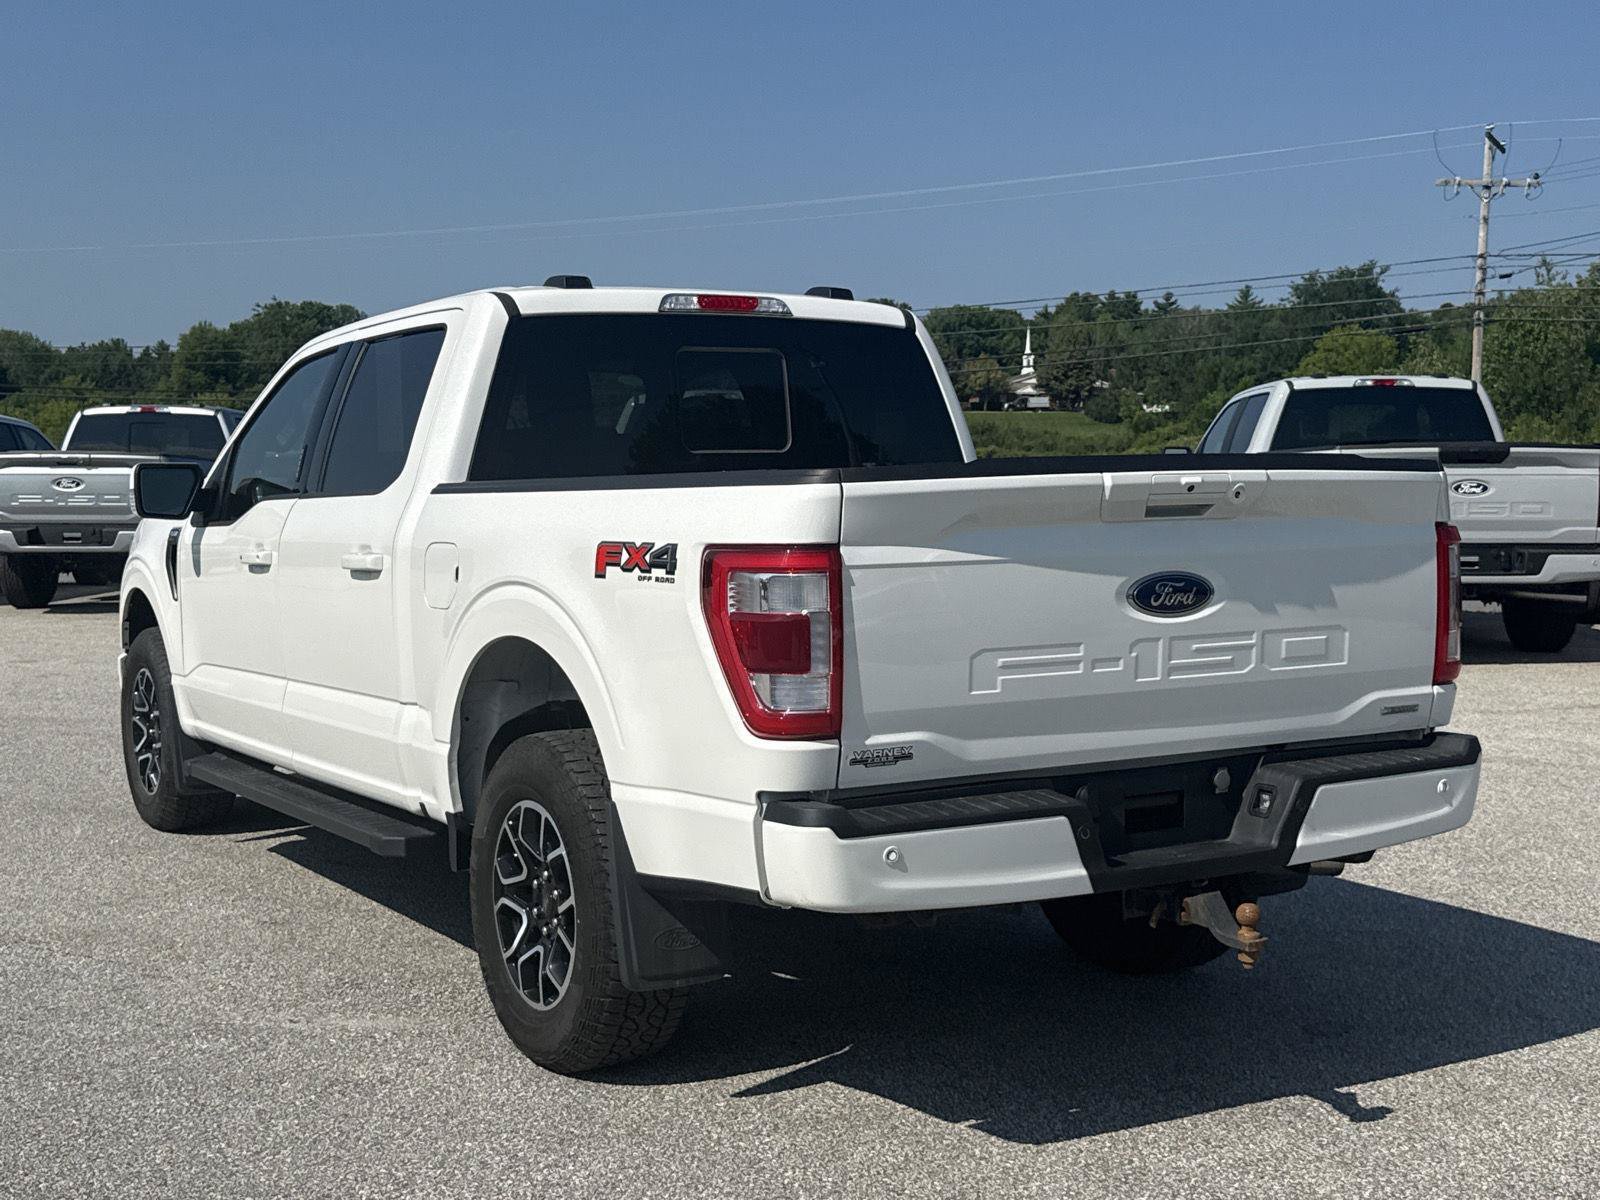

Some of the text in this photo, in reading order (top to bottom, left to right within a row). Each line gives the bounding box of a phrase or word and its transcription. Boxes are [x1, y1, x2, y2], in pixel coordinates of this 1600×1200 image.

[59, 478, 77, 489] Ford
[1458, 482, 1483, 494] Ford
[11, 494, 128, 506] F-150
[1451, 501, 1554, 518] 150
[595, 541, 678, 579] FX4
[655, 576, 675, 584] ROAD
[1150, 581, 1197, 607] Ford
[969, 624, 1350, 695] F-150
[853, 746, 913, 760] VARNEY
